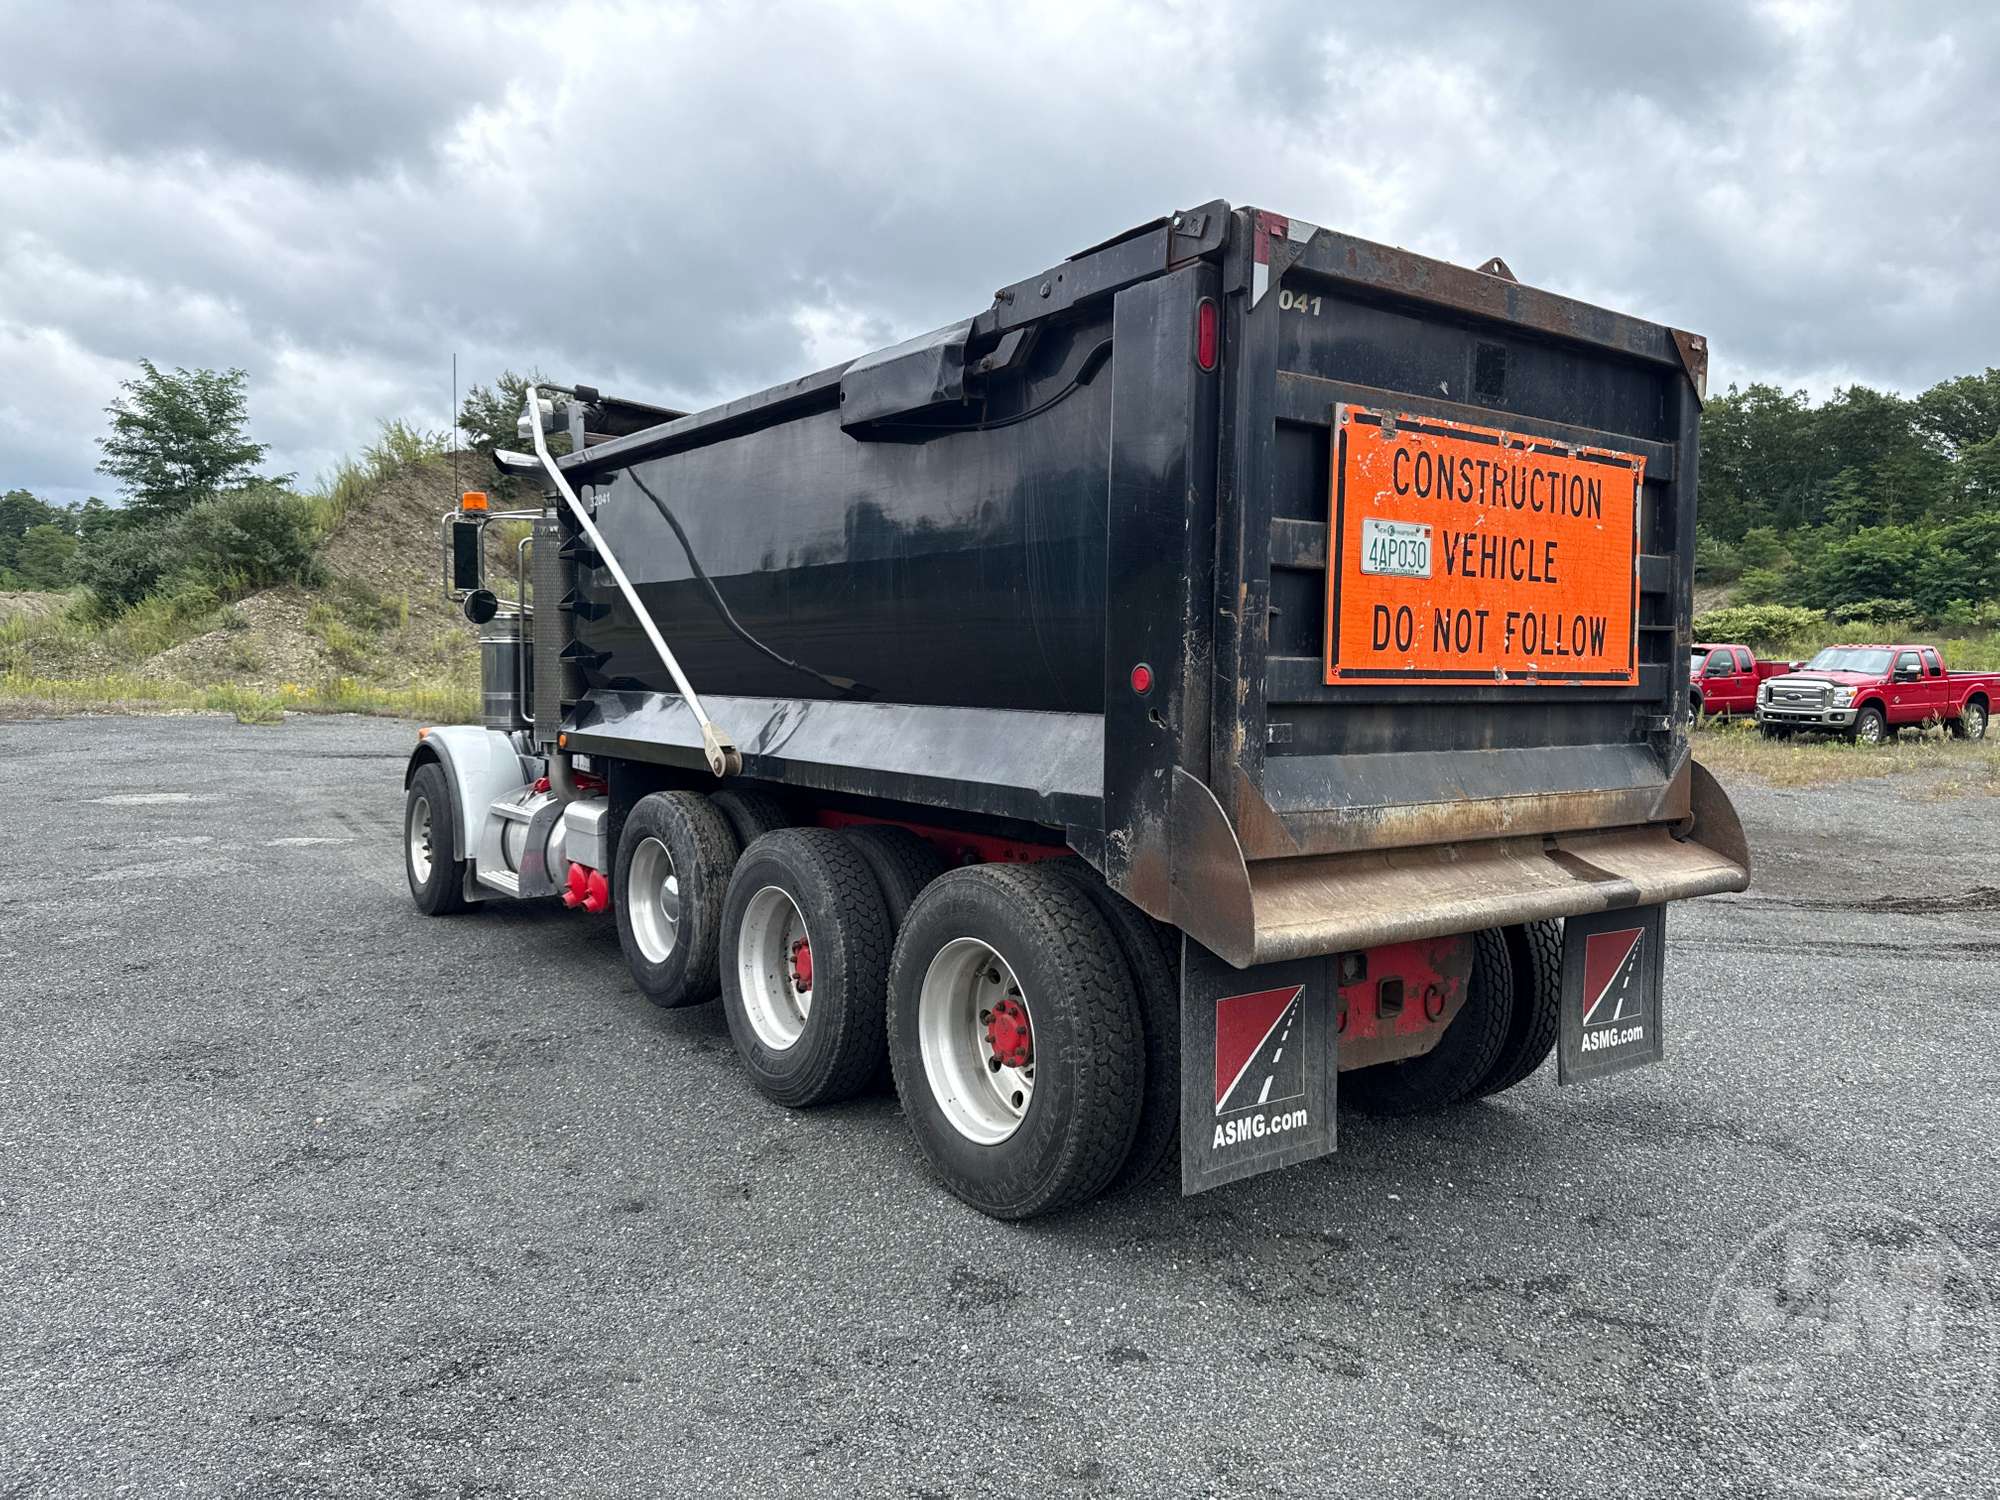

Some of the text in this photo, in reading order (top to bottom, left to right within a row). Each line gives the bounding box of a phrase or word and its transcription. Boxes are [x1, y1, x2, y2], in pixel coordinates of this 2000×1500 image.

[1393, 447, 1602, 519] CONSTRUCTION
[1369, 537, 1427, 569] 4AP030
[1443, 530, 1558, 584] VEHICLE
[1372, 605, 1607, 657] DO NOT FOLLOW
[1581, 1025, 1643, 1052] ASMG.com
[1212, 1109, 1308, 1149] ASMG.com
